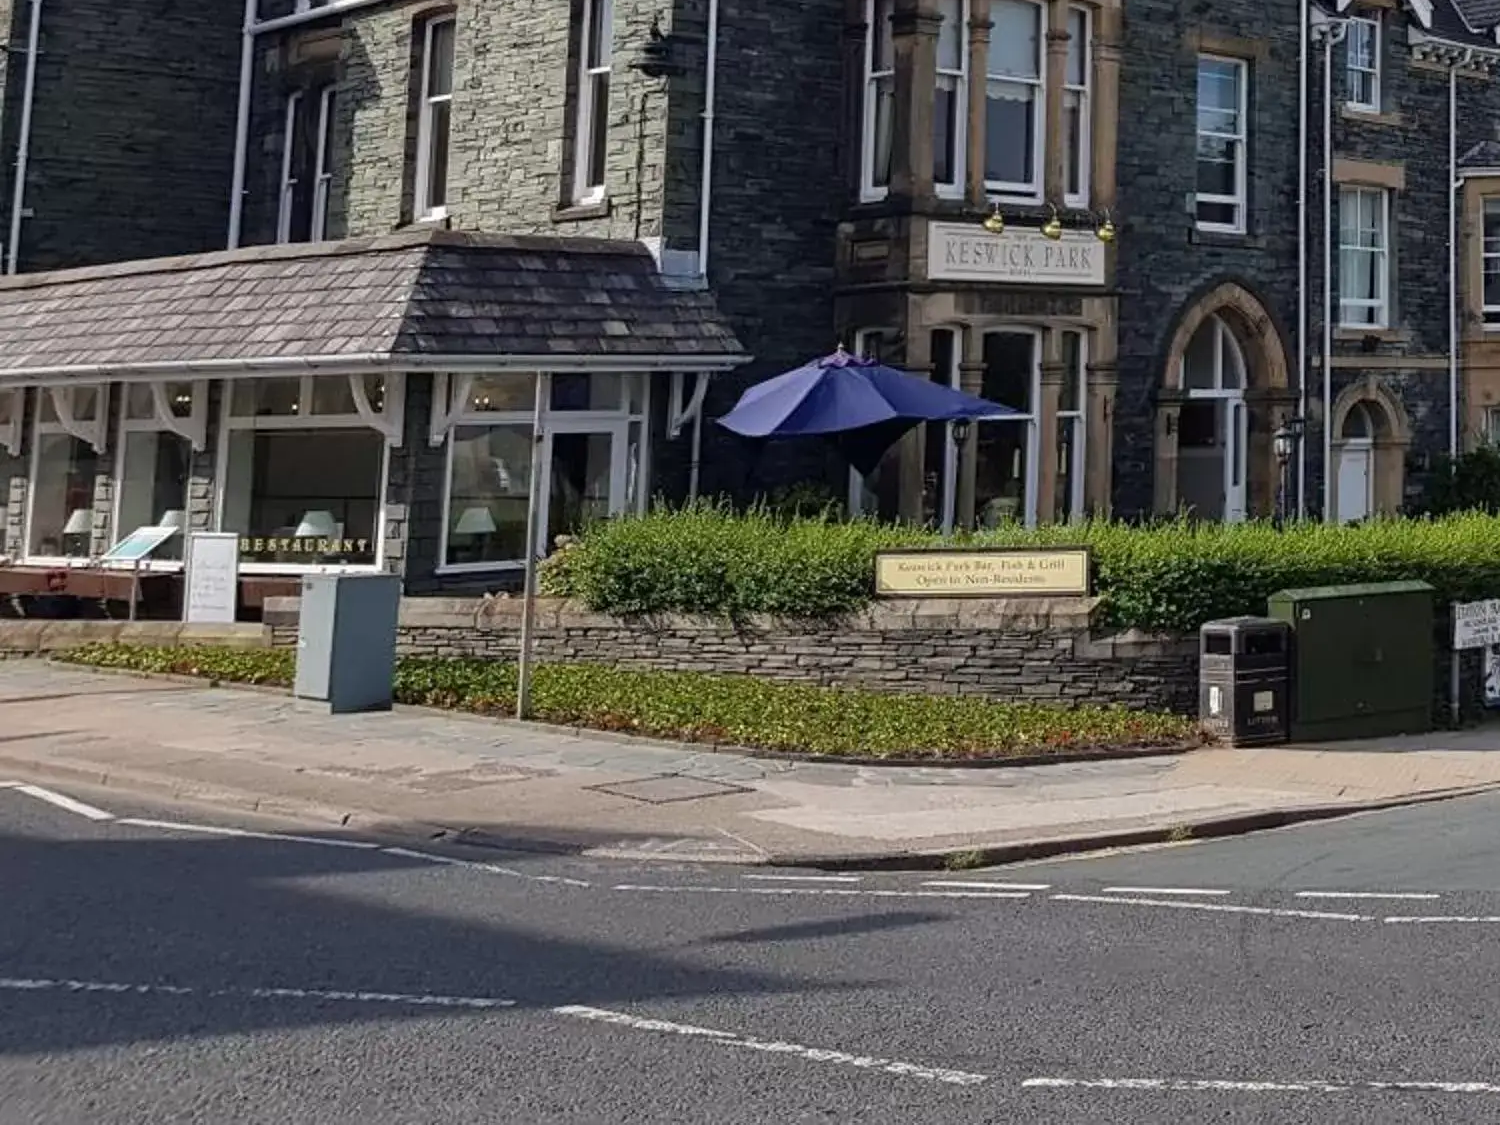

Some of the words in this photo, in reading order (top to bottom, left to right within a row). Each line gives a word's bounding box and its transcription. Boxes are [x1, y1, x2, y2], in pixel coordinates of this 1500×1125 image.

[945, 240, 1035, 268] KESWICK
[1044, 245, 1092, 270] PARK
[239, 538, 367, 552] RESTAURANT
[916, 575, 946, 587] Open
